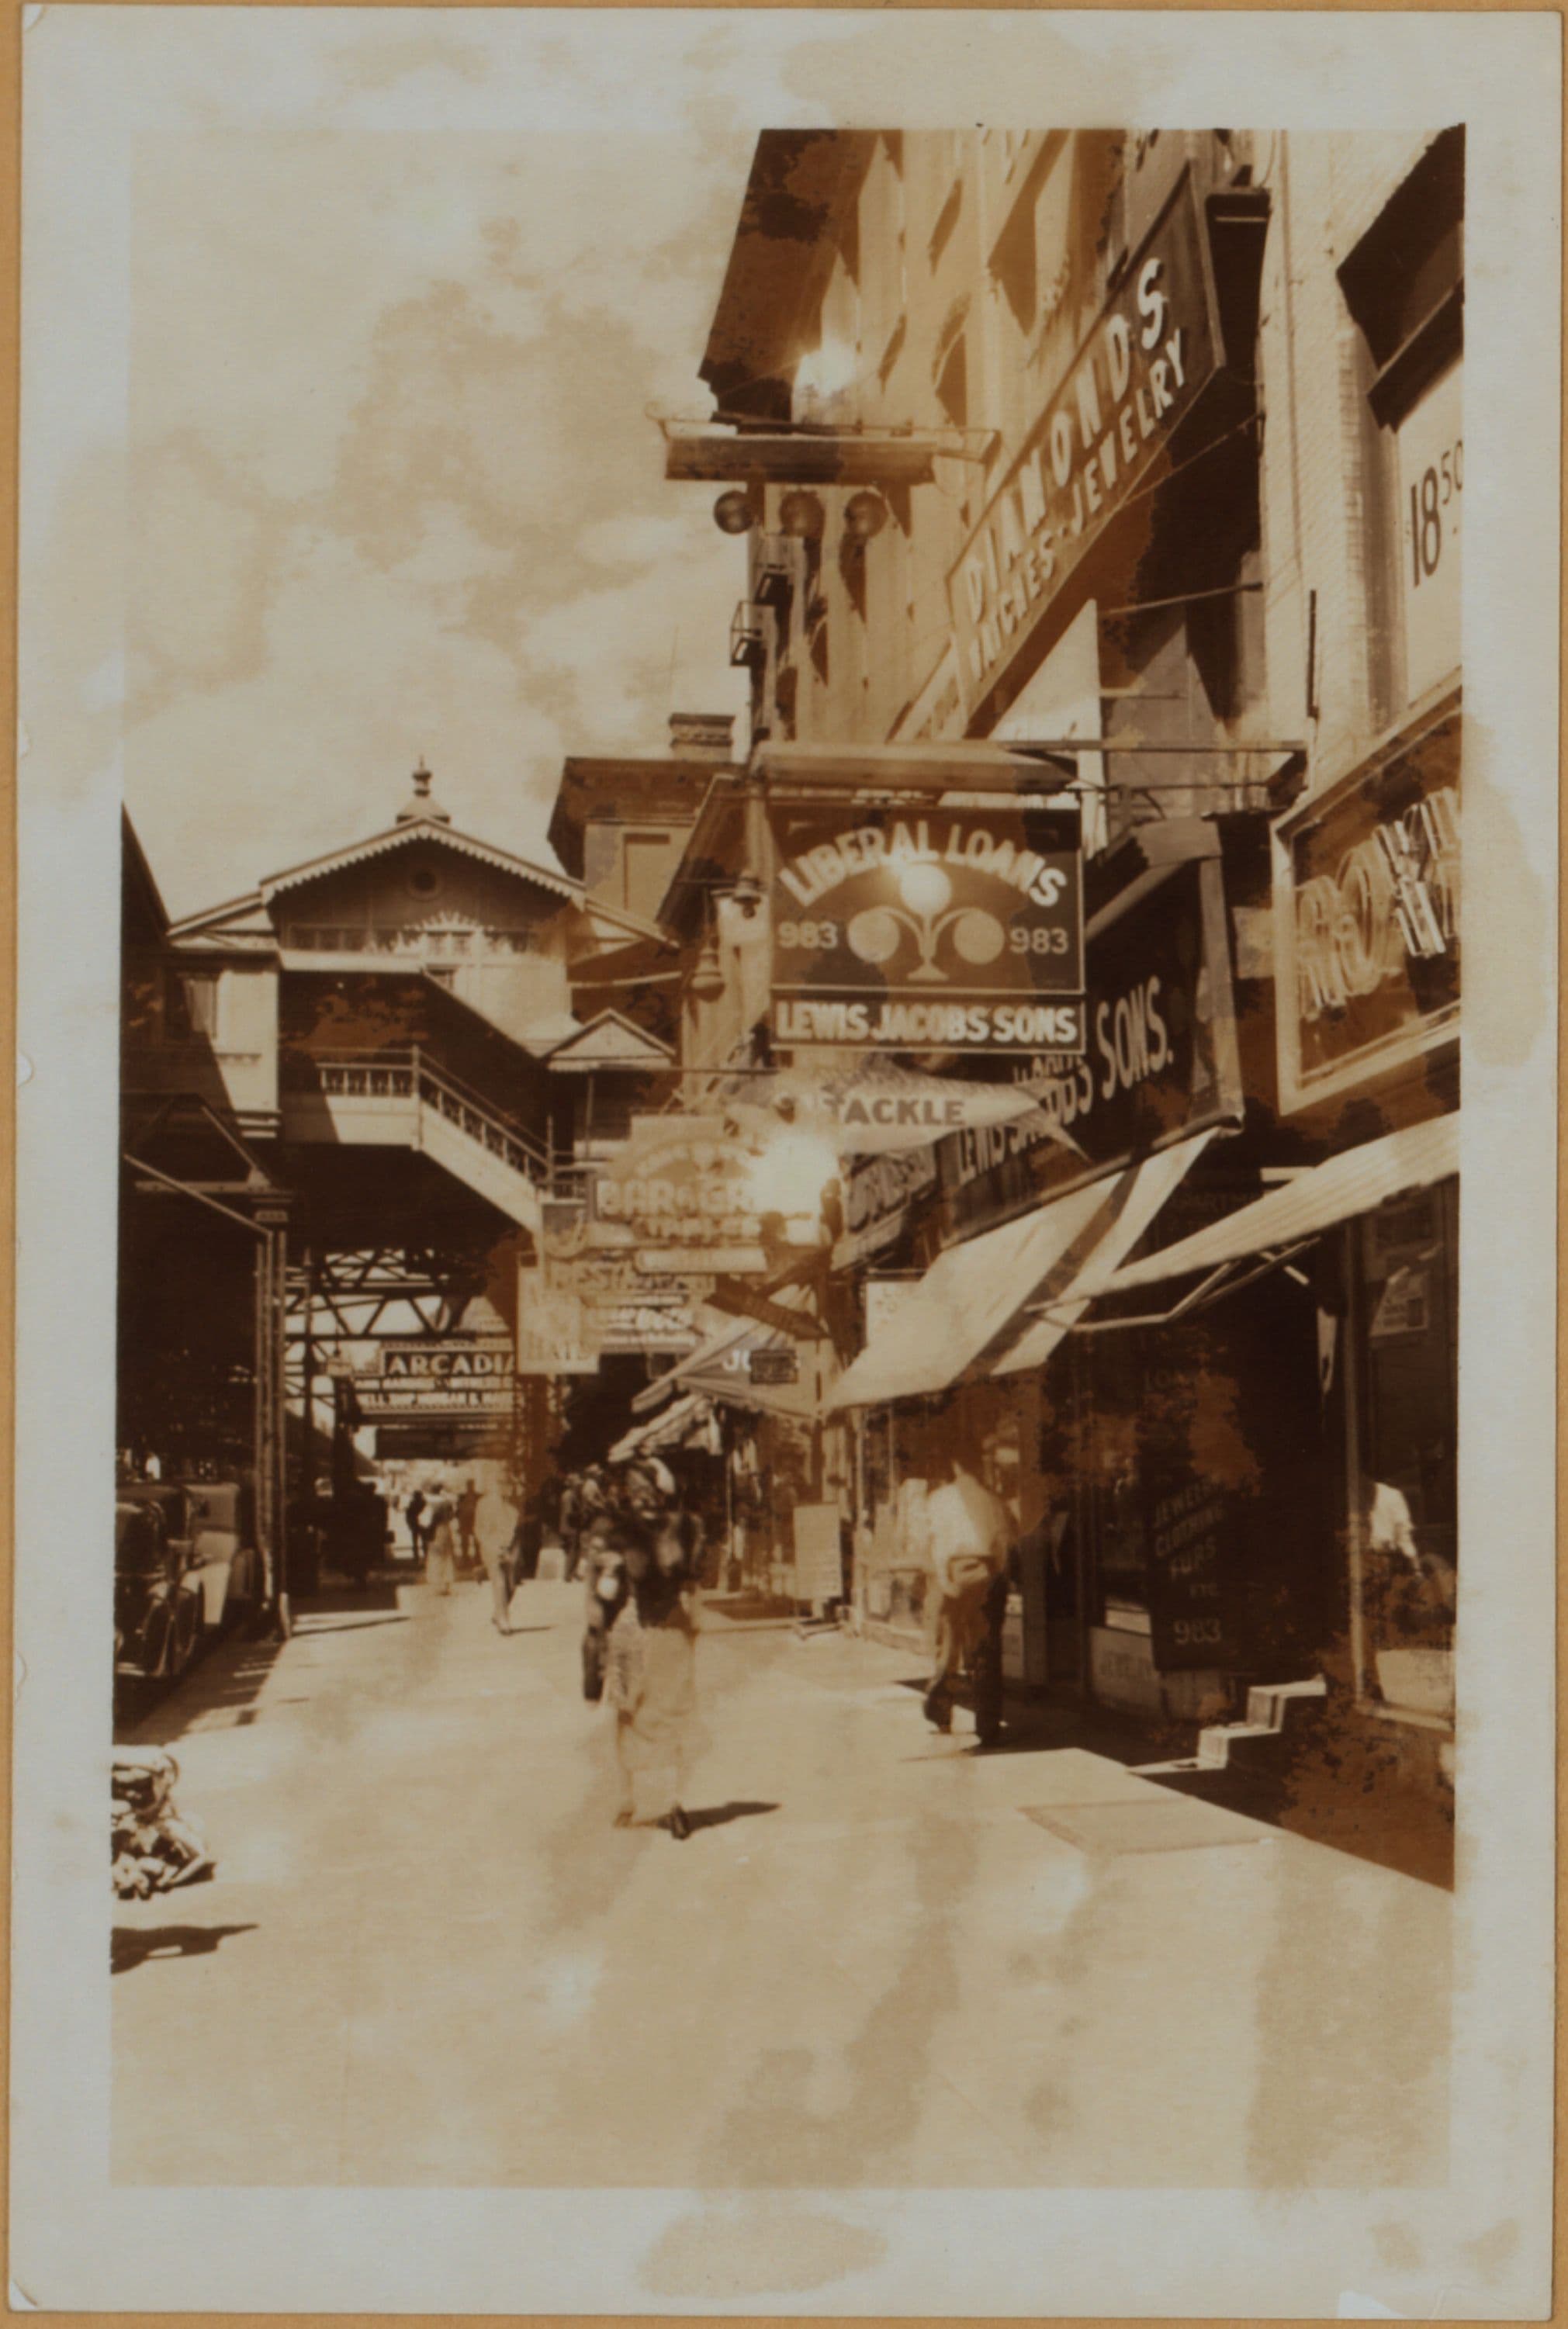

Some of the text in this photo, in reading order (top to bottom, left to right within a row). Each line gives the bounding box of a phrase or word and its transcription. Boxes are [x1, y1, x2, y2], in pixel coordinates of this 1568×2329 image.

[967, 258, 1168, 623] DIAMONDS
[1070, 327, 1187, 535] JEWELRY
[777, 820, 1068, 908] LIBERAL LOANS
[778, 920, 839, 950] 983
[1009, 926, 1070, 956] 983
[777, 1002, 1078, 1043] LEWIS JACOBS SONS
[822, 1098, 966, 1126] TACKLE
